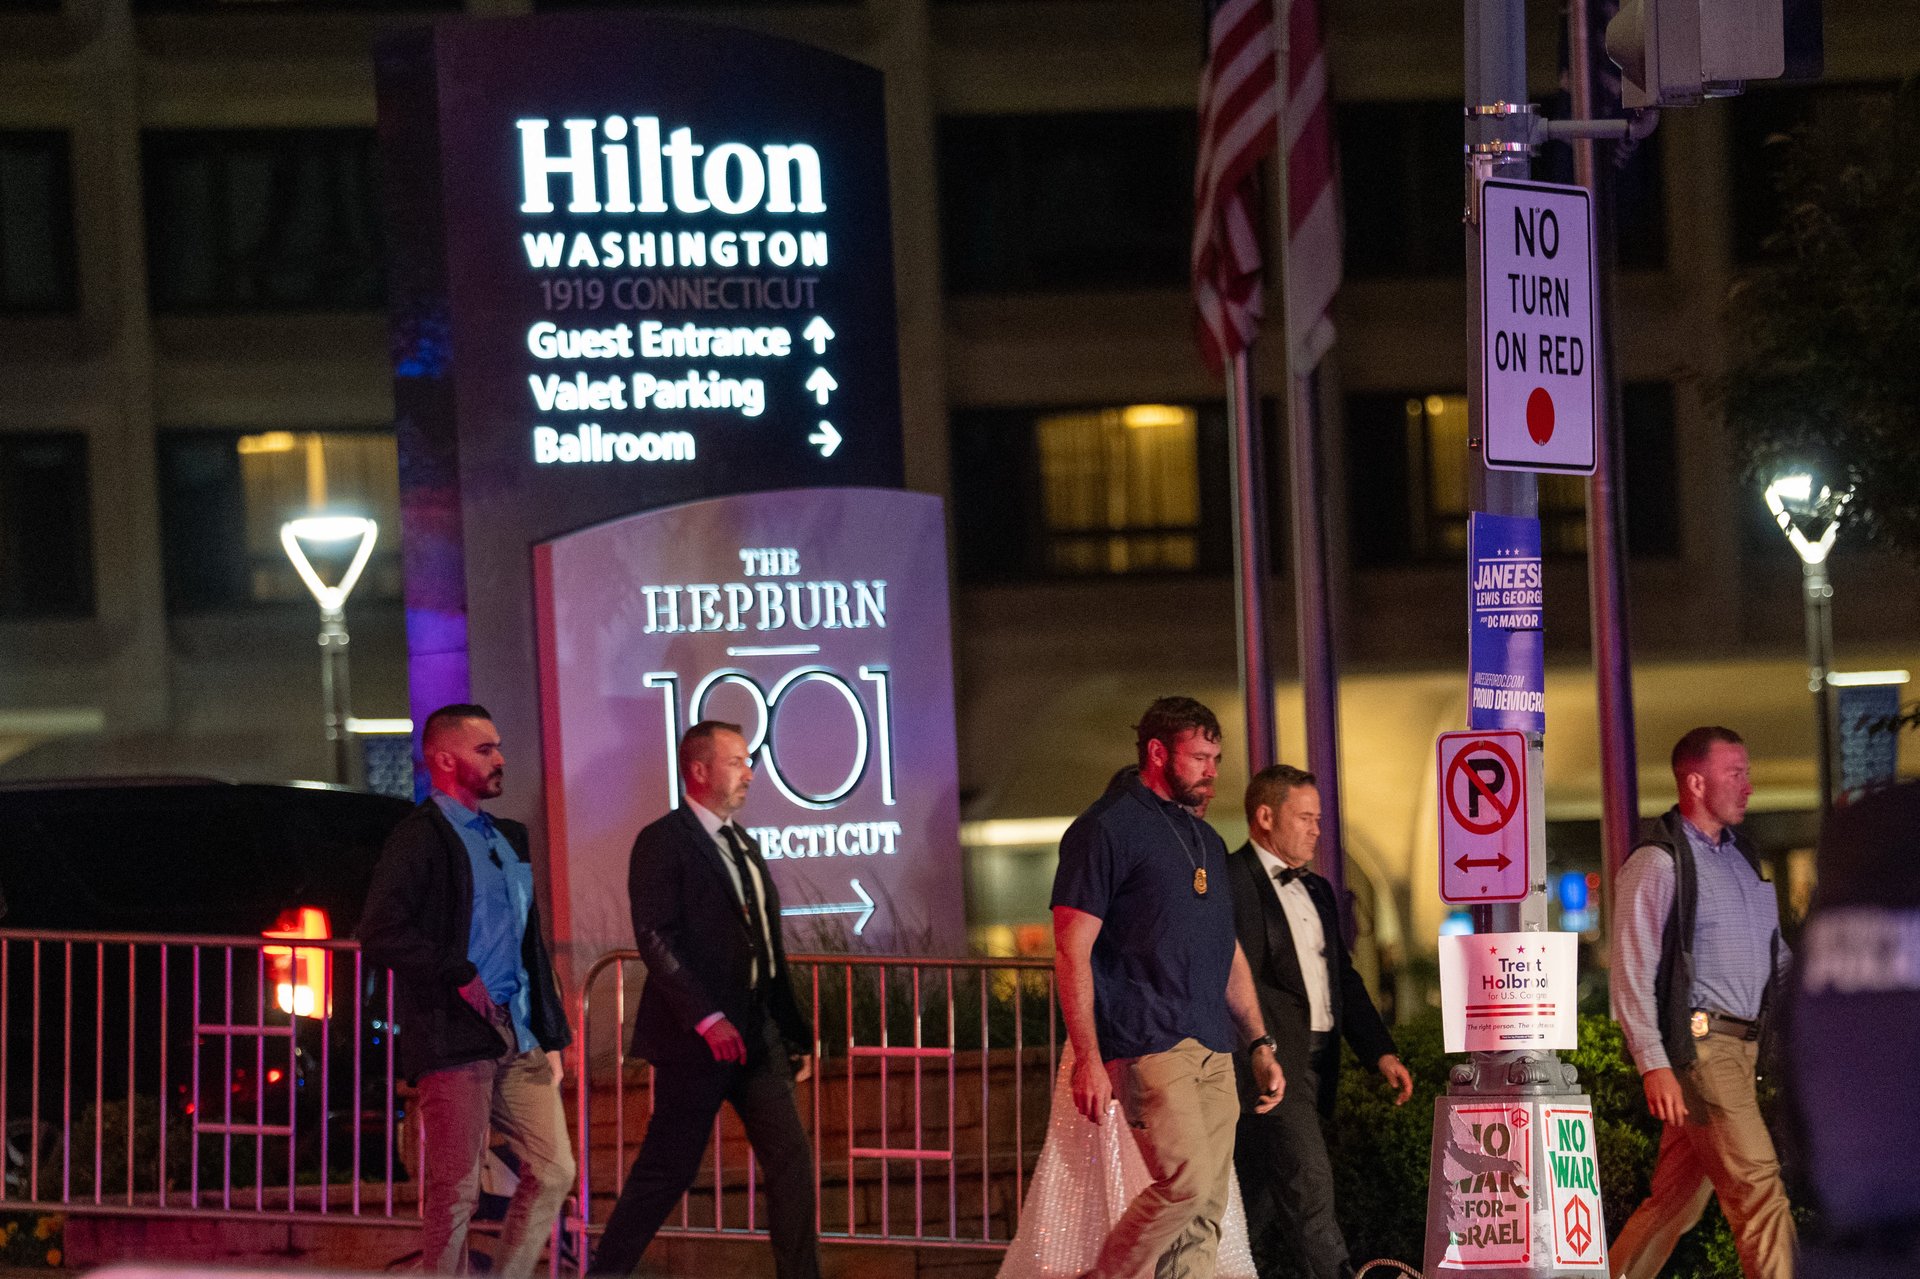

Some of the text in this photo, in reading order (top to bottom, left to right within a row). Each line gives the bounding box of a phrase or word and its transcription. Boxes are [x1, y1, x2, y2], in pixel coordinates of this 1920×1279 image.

[516, 115, 827, 214] Hilton
[523, 231, 828, 268] WASHINGTON
[1514, 206, 1559, 259] NO
[540, 277, 820, 311] 1919 CONNECTICUT
[1508, 273, 1570, 318] TURN
[527, 320, 792, 359] Guest Entrance
[1495, 330, 1584, 376] ON RED
[528, 370, 766, 417] Valet Parking
[533, 423, 696, 464] Ballroom
[739, 547, 801, 576] THE
[641, 580, 888, 634] HEPBURN
[1476, 589, 1542, 607] LEWIS GEORG
[1487, 614, 1499, 628] DC
[1499, 614, 1539, 628] MAYOR
[1473, 687, 1545, 713] PROUD DEMOCR
[1482, 973, 1549, 990] Holbro
[1488, 992, 1498, 1000] for
[1500, 991, 1518, 1000] U.S.
[1558, 1119, 1586, 1153] NO
[1548, 1151, 1599, 1196] WAR
